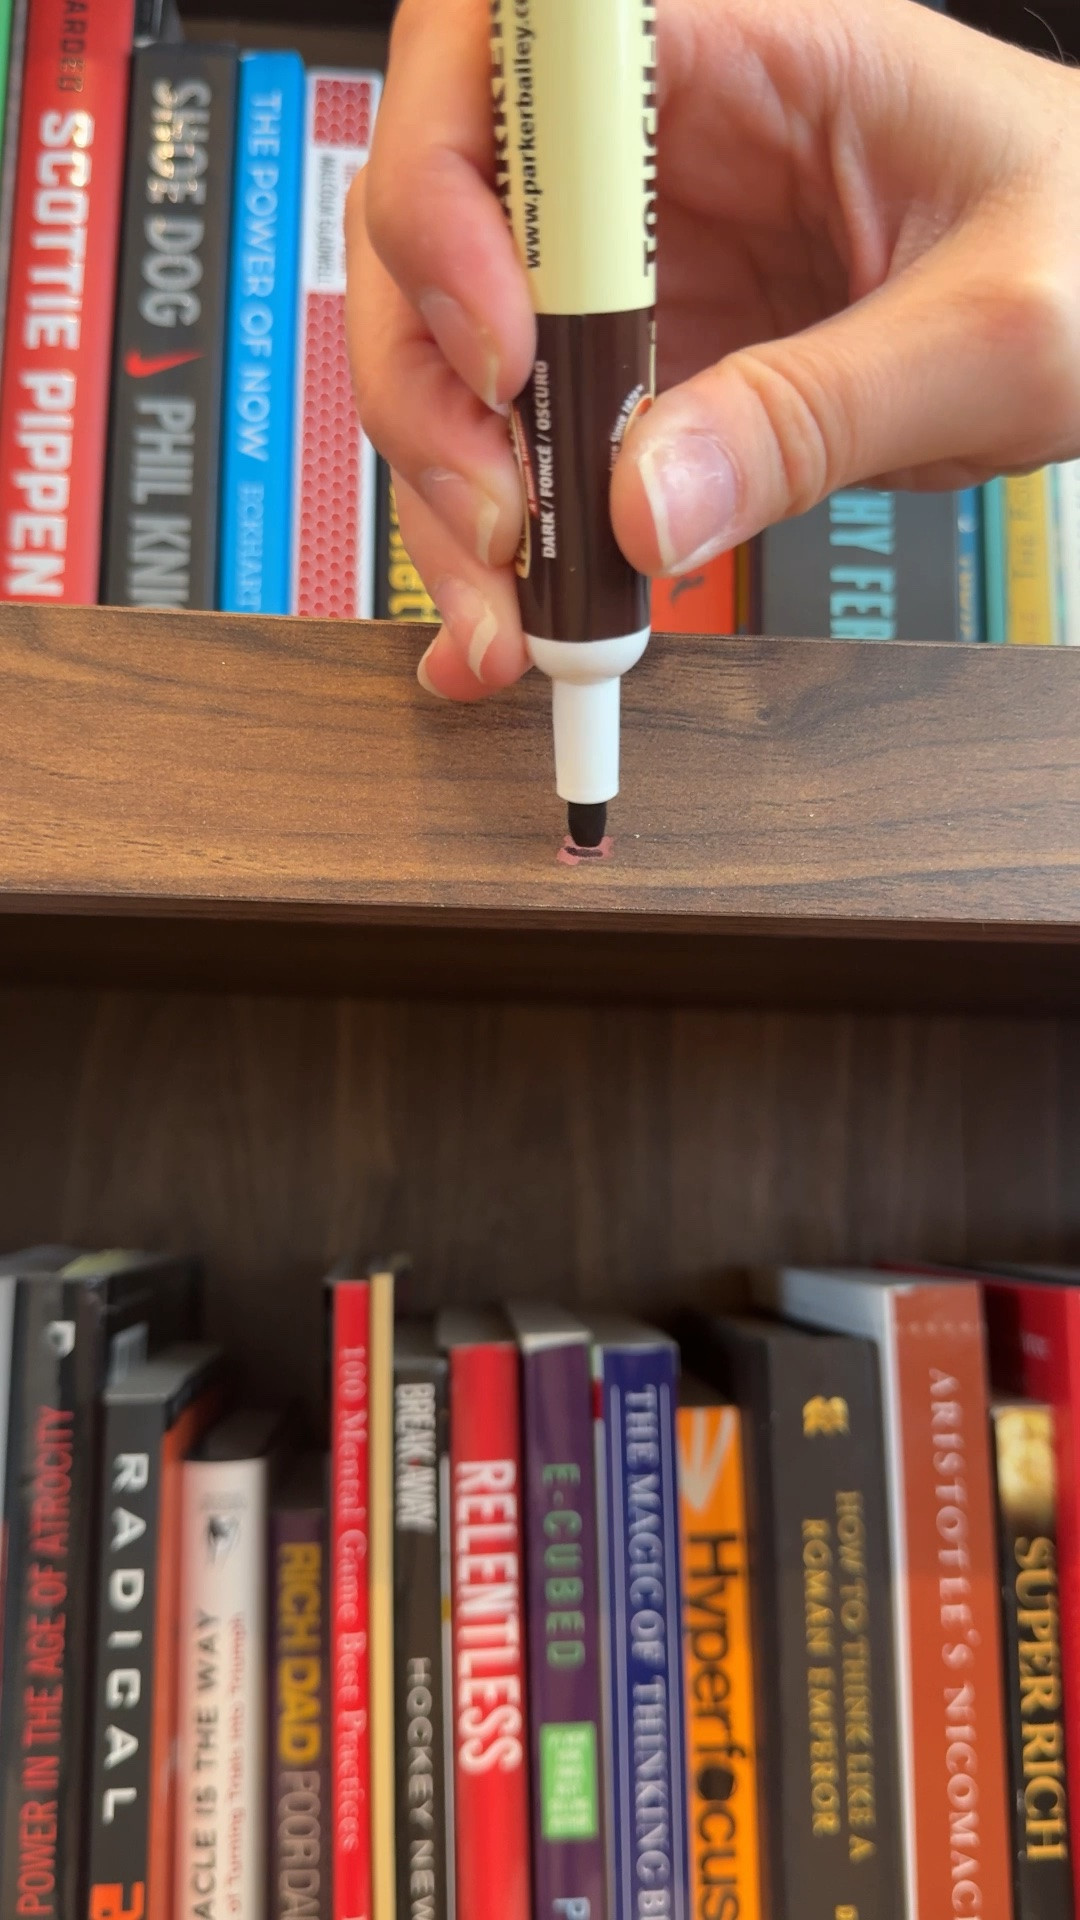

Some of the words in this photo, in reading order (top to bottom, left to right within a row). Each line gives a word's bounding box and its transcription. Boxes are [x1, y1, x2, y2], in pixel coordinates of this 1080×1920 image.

[147, 77, 211, 205] SHOE
[248, 90, 283, 157] THE
[23, 110, 94, 351] SCOTTIE
[140, 215, 204, 328] DOG
[241, 162, 279, 299] POWER
[239, 307, 274, 363] OF
[235, 370, 272, 461] NOW
[534, 360, 552, 431] OSCURO
[8, 369, 76, 597] PIPPEN
[132, 396, 196, 503] PHIL
[536, 445, 553, 498] FONCÉ
[127, 515, 194, 610] KNI
[540, 511, 556, 559] DARK
[829, 488, 896, 555] HY
[339, 1345, 367, 1397] 100
[339, 1408, 367, 1519] Mental
[395, 1383, 436, 1459] BREAK
[624, 1383, 660, 1466] THE
[28, 1403, 75, 1559] ATROCITY
[338, 1529, 367, 1624] Game
[541, 1462, 586, 1671] E-CUBED
[626, 1471, 665, 1606] MAGIC
[834, 1489, 866, 1576] HOW
[26, 1562, 69, 1606] OF
[278, 1542, 321, 1653] RICH
[455, 1458, 523, 1775] RELENTLESS
[801, 1518, 836, 1657] ROMAN
[838, 1576, 870, 1633] TO
[1012, 1535, 1061, 1713] SUPER
[24, 1612, 67, 1679] AGE
[102, 1451, 150, 1825] RADICAL
[194, 1608, 221, 1691] WAY
[339, 1631, 367, 1700] Best
[630, 1608, 666, 1670] OF
[22, 1683, 65, 1749] THE
[277, 1657, 321, 1766] DAD
[841, 1634, 875, 1749] THINK
[20, 1754, 62, 1792] IN
[193, 1706, 219, 1774] THE
[338, 1708, 367, 1852] Practices
[406, 1657, 435, 1829] HOCKEY
[632, 1675, 670, 1882] THINKING
[807, 1665, 842, 1838] EMPEROR
[192, 1786, 218, 1817] IS
[277, 1769, 321, 1866] POOR
[845, 1752, 878, 1830] LIKE
[942, 1681, 984, 1920] NICOMAC
[1020, 1716, 1069, 1863] RICH
[15, 1798, 58, 1917] POWER
[277, 1868, 321, 1920] DA
[848, 1833, 879, 1865] A
